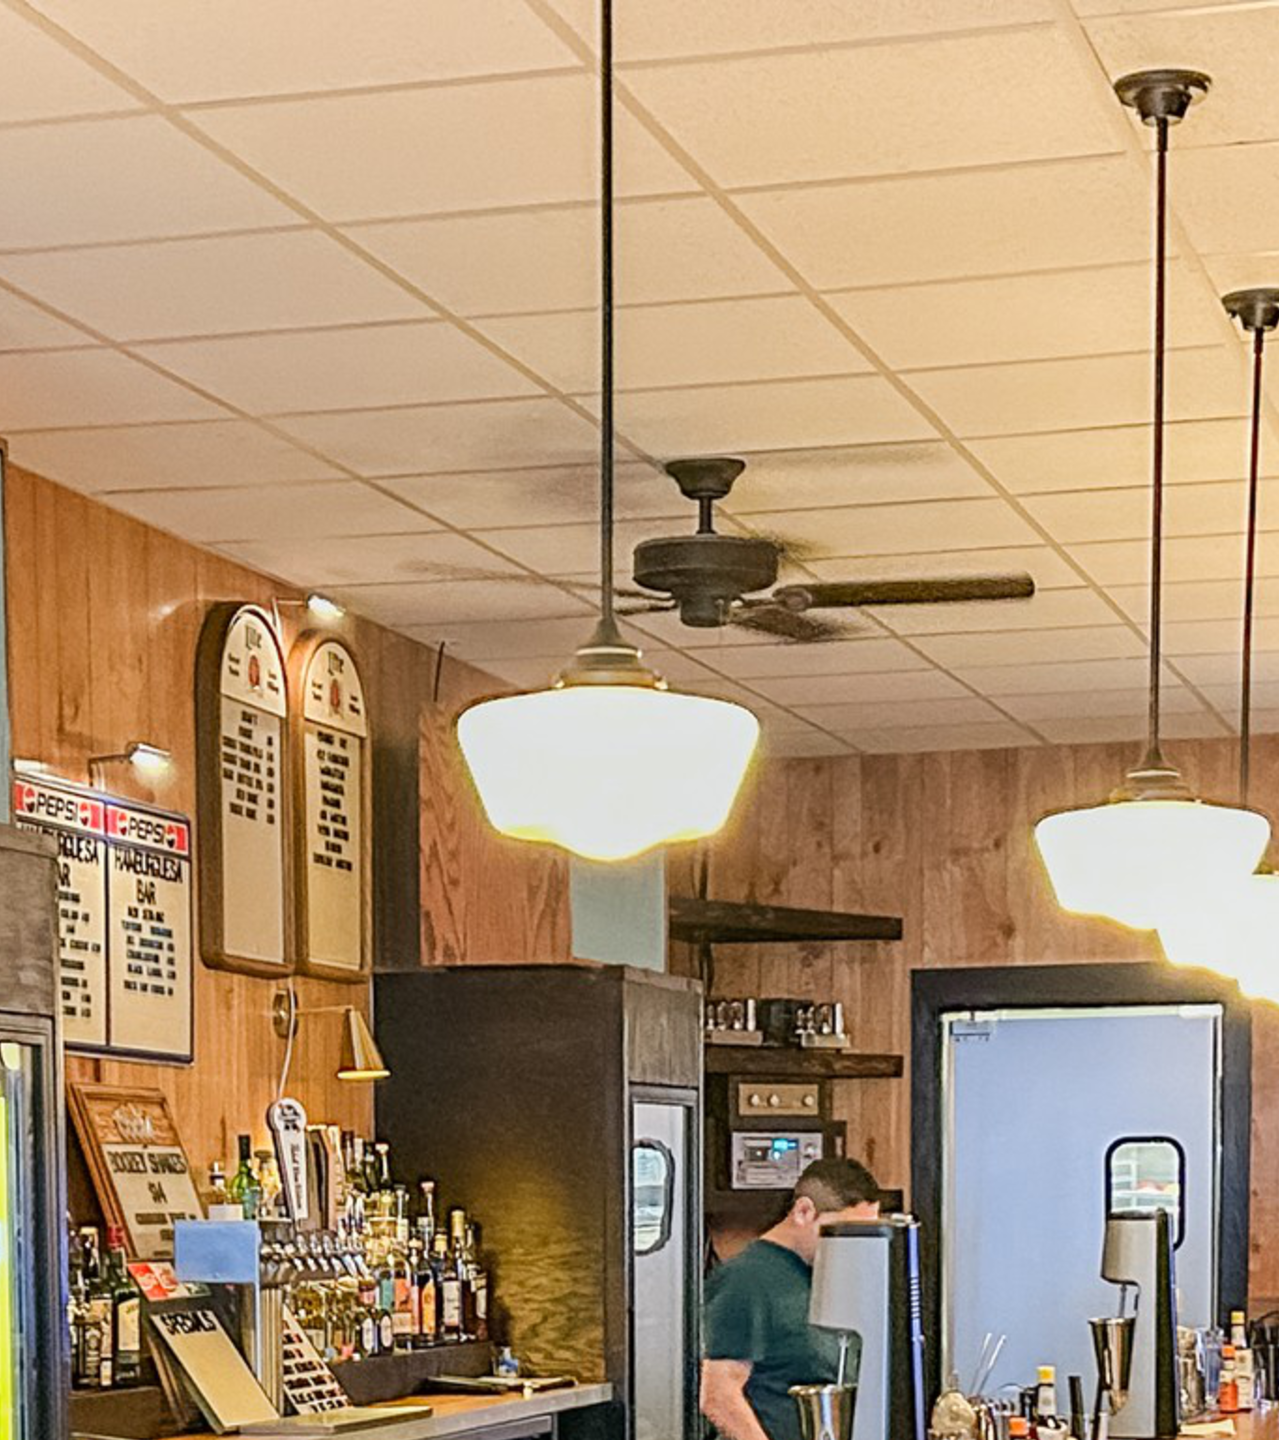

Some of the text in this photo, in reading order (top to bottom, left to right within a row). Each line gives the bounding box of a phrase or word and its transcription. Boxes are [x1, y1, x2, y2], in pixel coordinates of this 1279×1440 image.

[36, 793, 78, 822] PEPSI
[128, 816, 165, 848] PEPSI
[136, 879, 156, 905] BAR
[147, 1152, 188, 1174] SHAKES
[161, 1309, 218, 1335] SPECIALS
